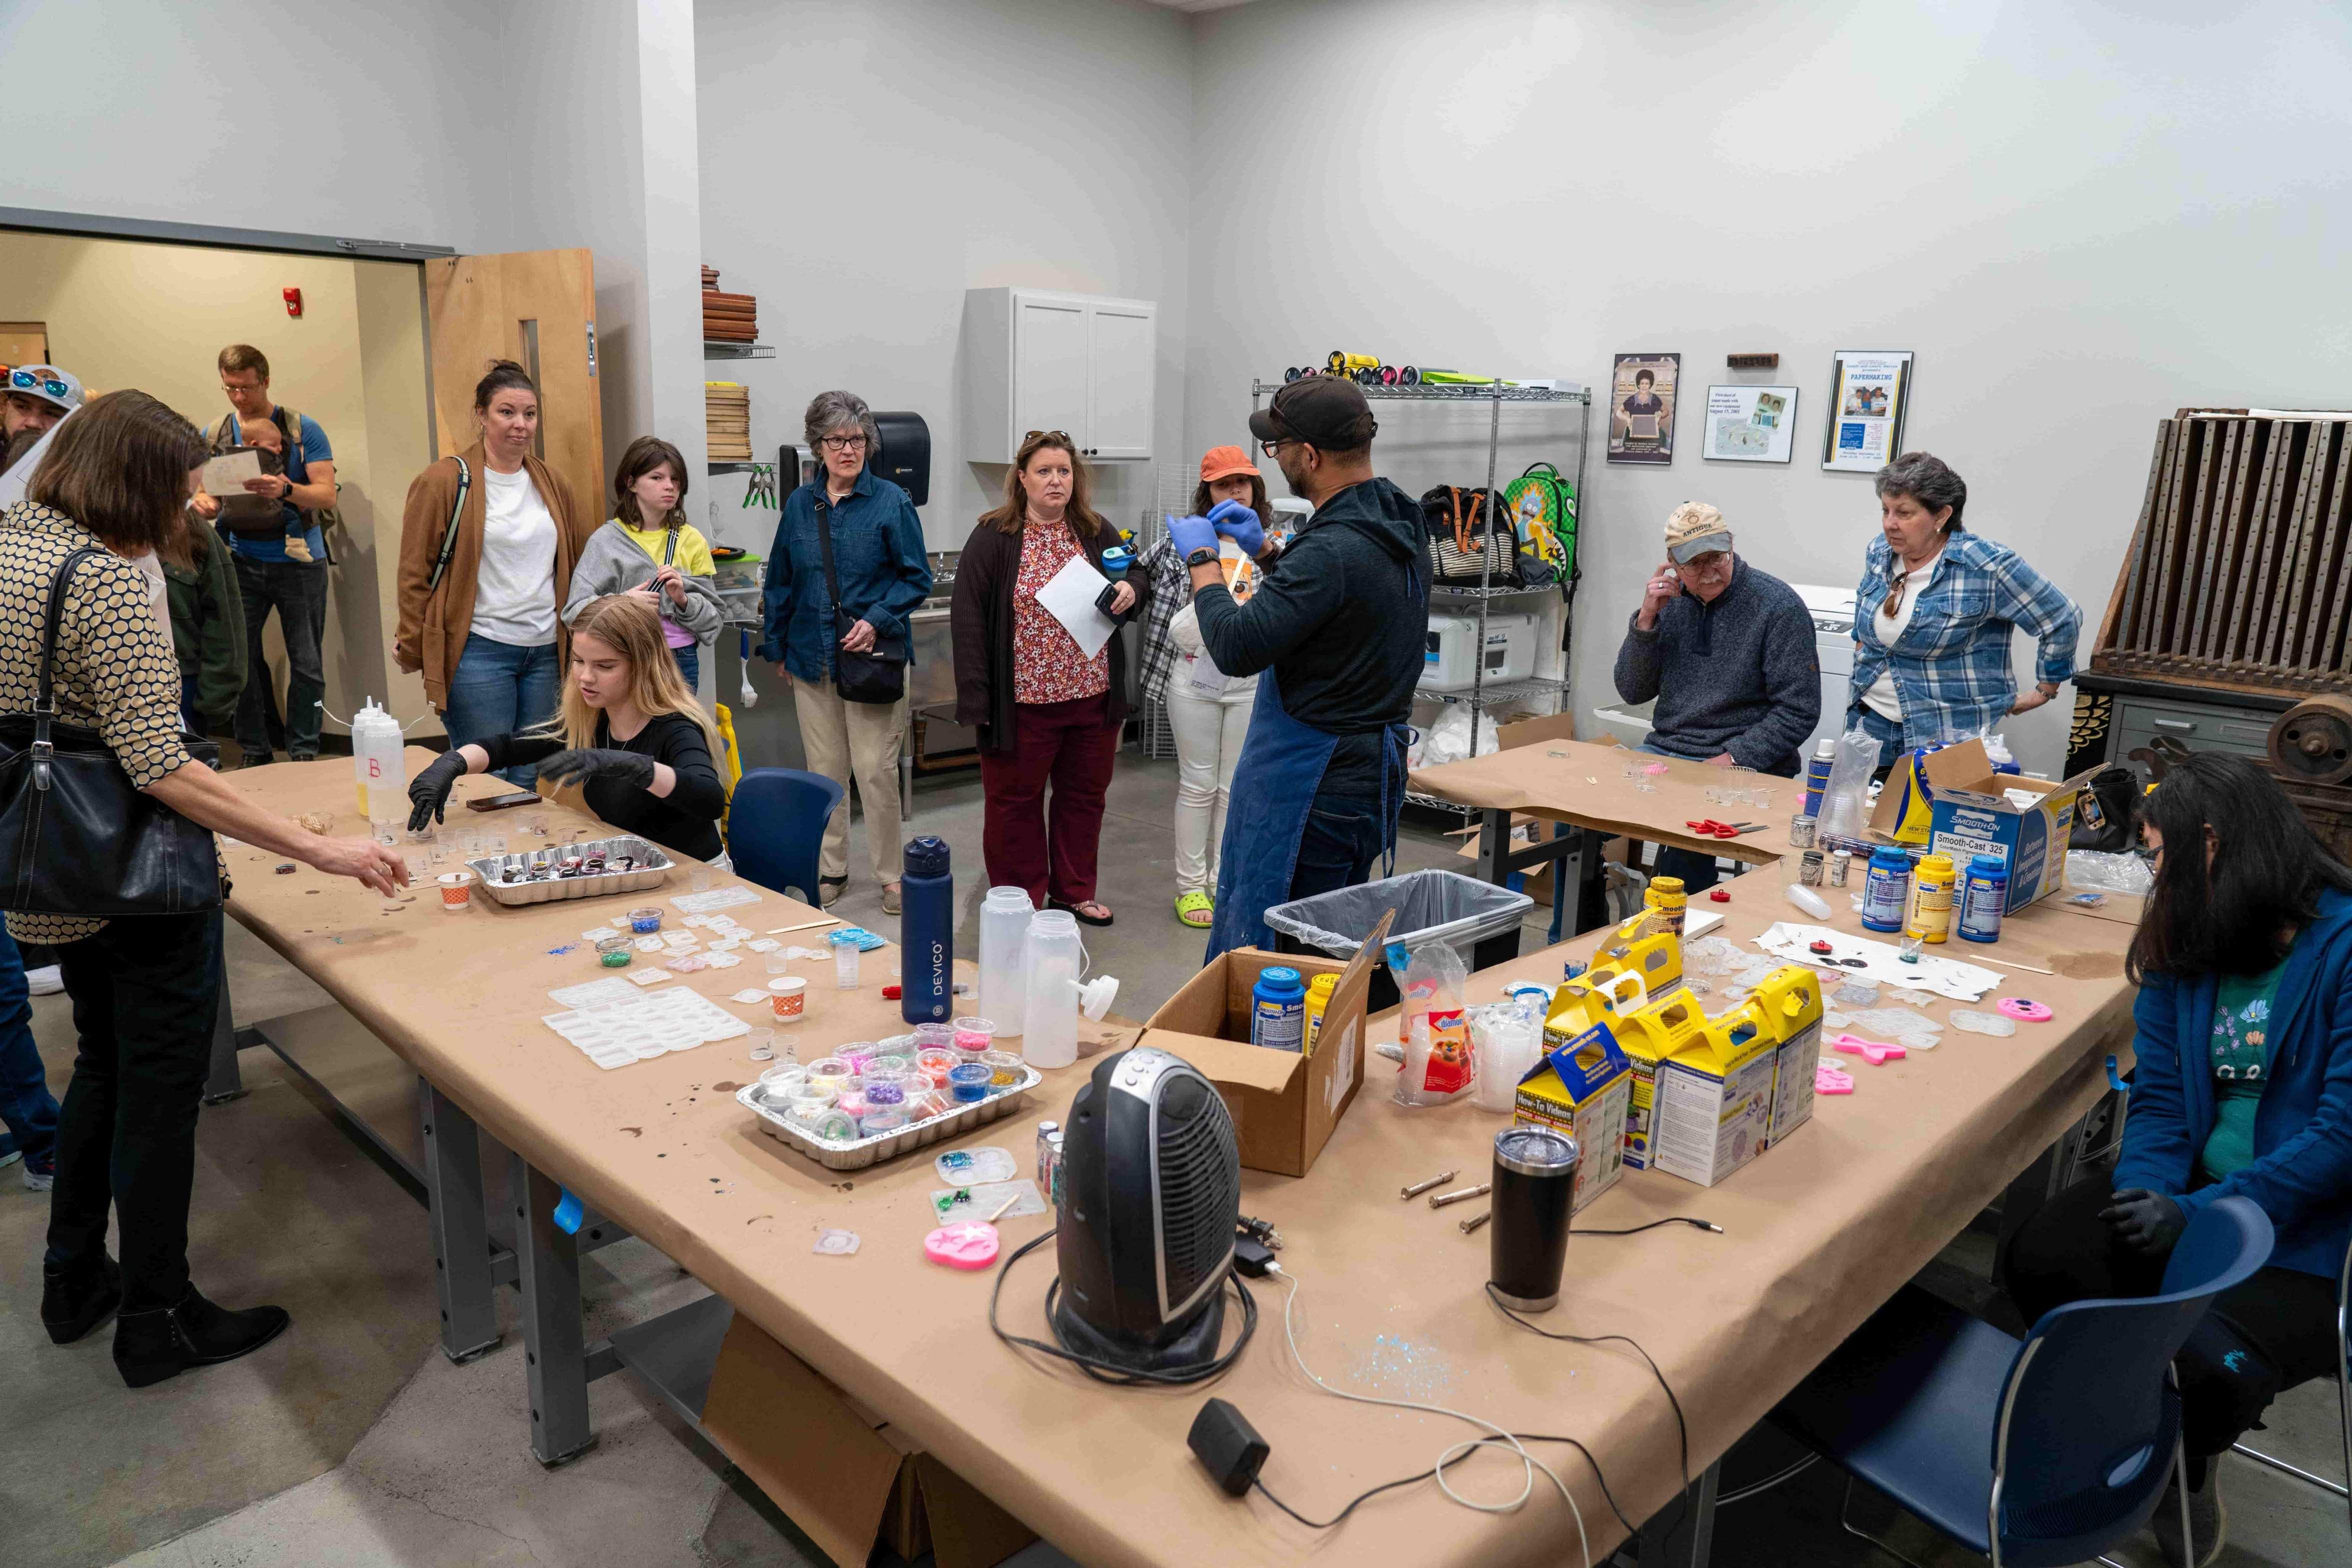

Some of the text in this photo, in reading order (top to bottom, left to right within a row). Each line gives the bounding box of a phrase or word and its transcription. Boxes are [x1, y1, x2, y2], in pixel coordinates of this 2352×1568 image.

[1683, 524, 1712, 537] ANTIGUA
[368, 758, 381, 778] B
[1950, 816, 2000, 831] SMOOTH-ON
[1939, 844, 1961, 852] ColorMatch
[1989, 844, 2003, 854] 325
[2024, 836, 2044, 856] Between
[2017, 849, 2045, 873] Imagination
[1918, 881, 1940, 889] SMOOTH-ON
[1258, 1005, 1286, 1015] SMOOTH-ON
[1630, 1057, 1653, 1073] Videos
[1636, 1075, 1654, 1084] CREATE
[1518, 1093, 1571, 1118] How-To Videos
[1516, 1108, 1572, 1130] WATCH LEARN CREATE
